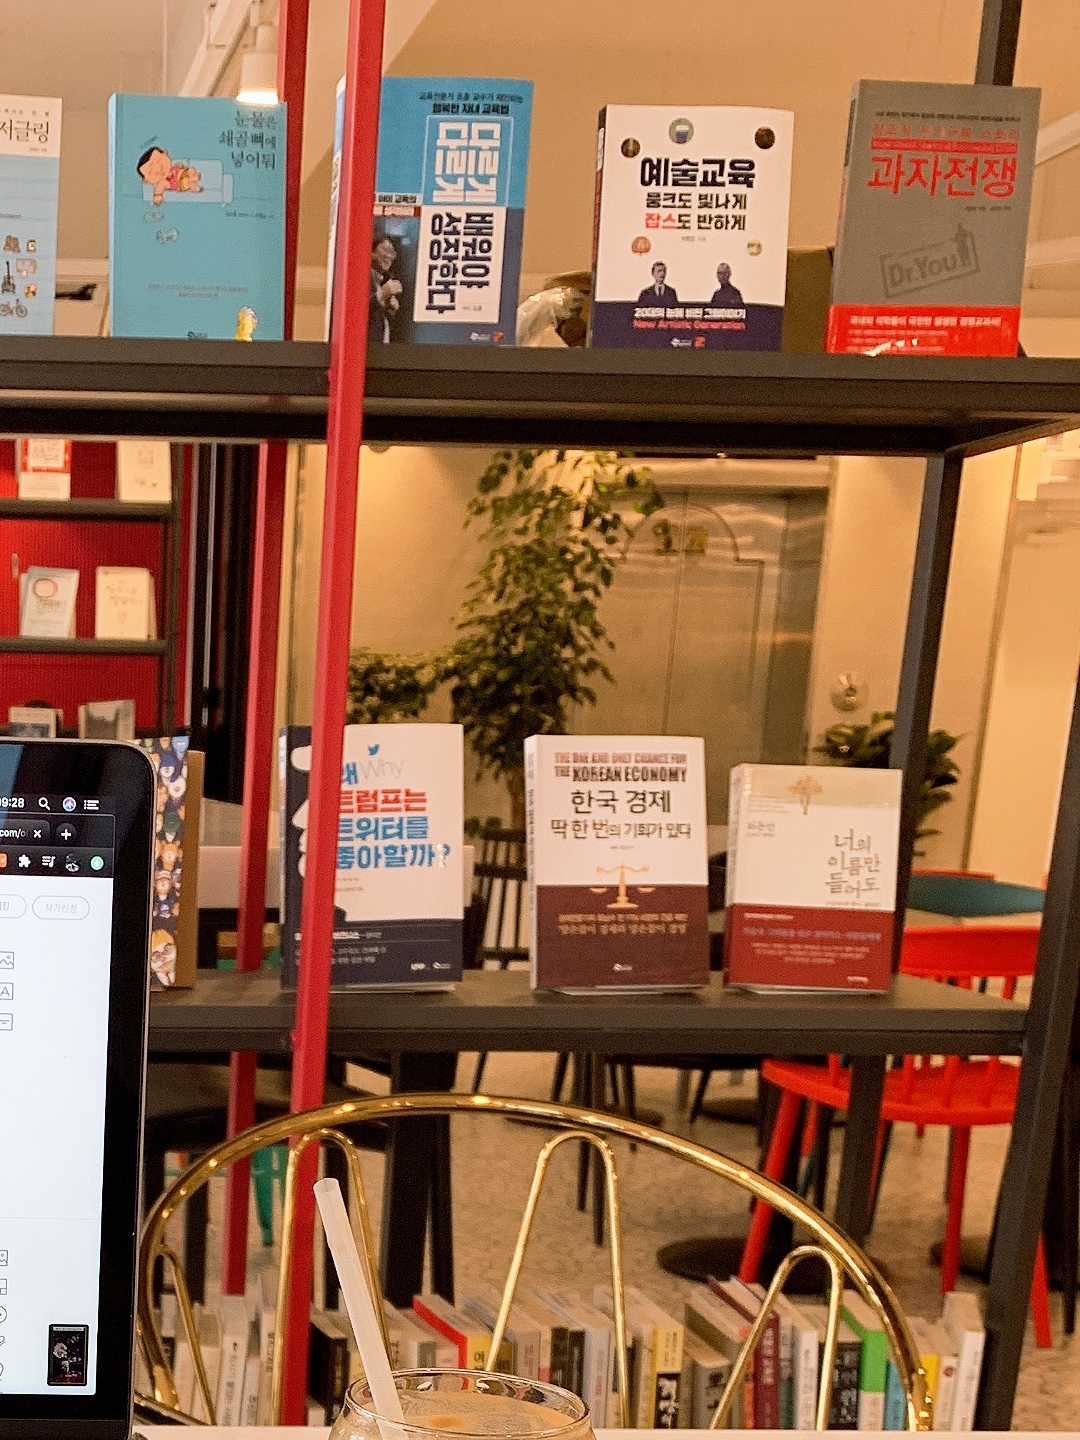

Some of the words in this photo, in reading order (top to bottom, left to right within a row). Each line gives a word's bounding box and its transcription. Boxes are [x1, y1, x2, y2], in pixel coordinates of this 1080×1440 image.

[234, 110, 277, 130] 눈물은
[432, 122, 469, 205] 다르게
[464, 122, 502, 205] 다르게
[640, 157, 756, 189] 예술교육
[866, 152, 1019, 199] 과자전쟁
[646, 192, 693, 209] 뭉크도
[697, 193, 748, 210] 빛나게
[644, 212, 692, 231] 잡스도
[696, 213, 747, 231] 반하게
[425, 212, 462, 314] 성장한다
[460, 212, 495, 289] 배워야
[359, 759, 405, 779] Why
[572, 766, 622, 782] KOREAN
[624, 766, 688, 783] ECONOMY
[571, 789, 620, 814] 한국
[626, 789, 672, 815] 경제
[551, 819, 569, 840] 딱
[572, 819, 589, 840] 한
[592, 819, 621, 839] 번의
[623, 822, 664, 840] 기회가
[666, 822, 692, 840] 있다
[833, 828, 872, 854] 너의
[827, 850, 882, 876] 이름만
[825, 872, 881, 899] 들어도
